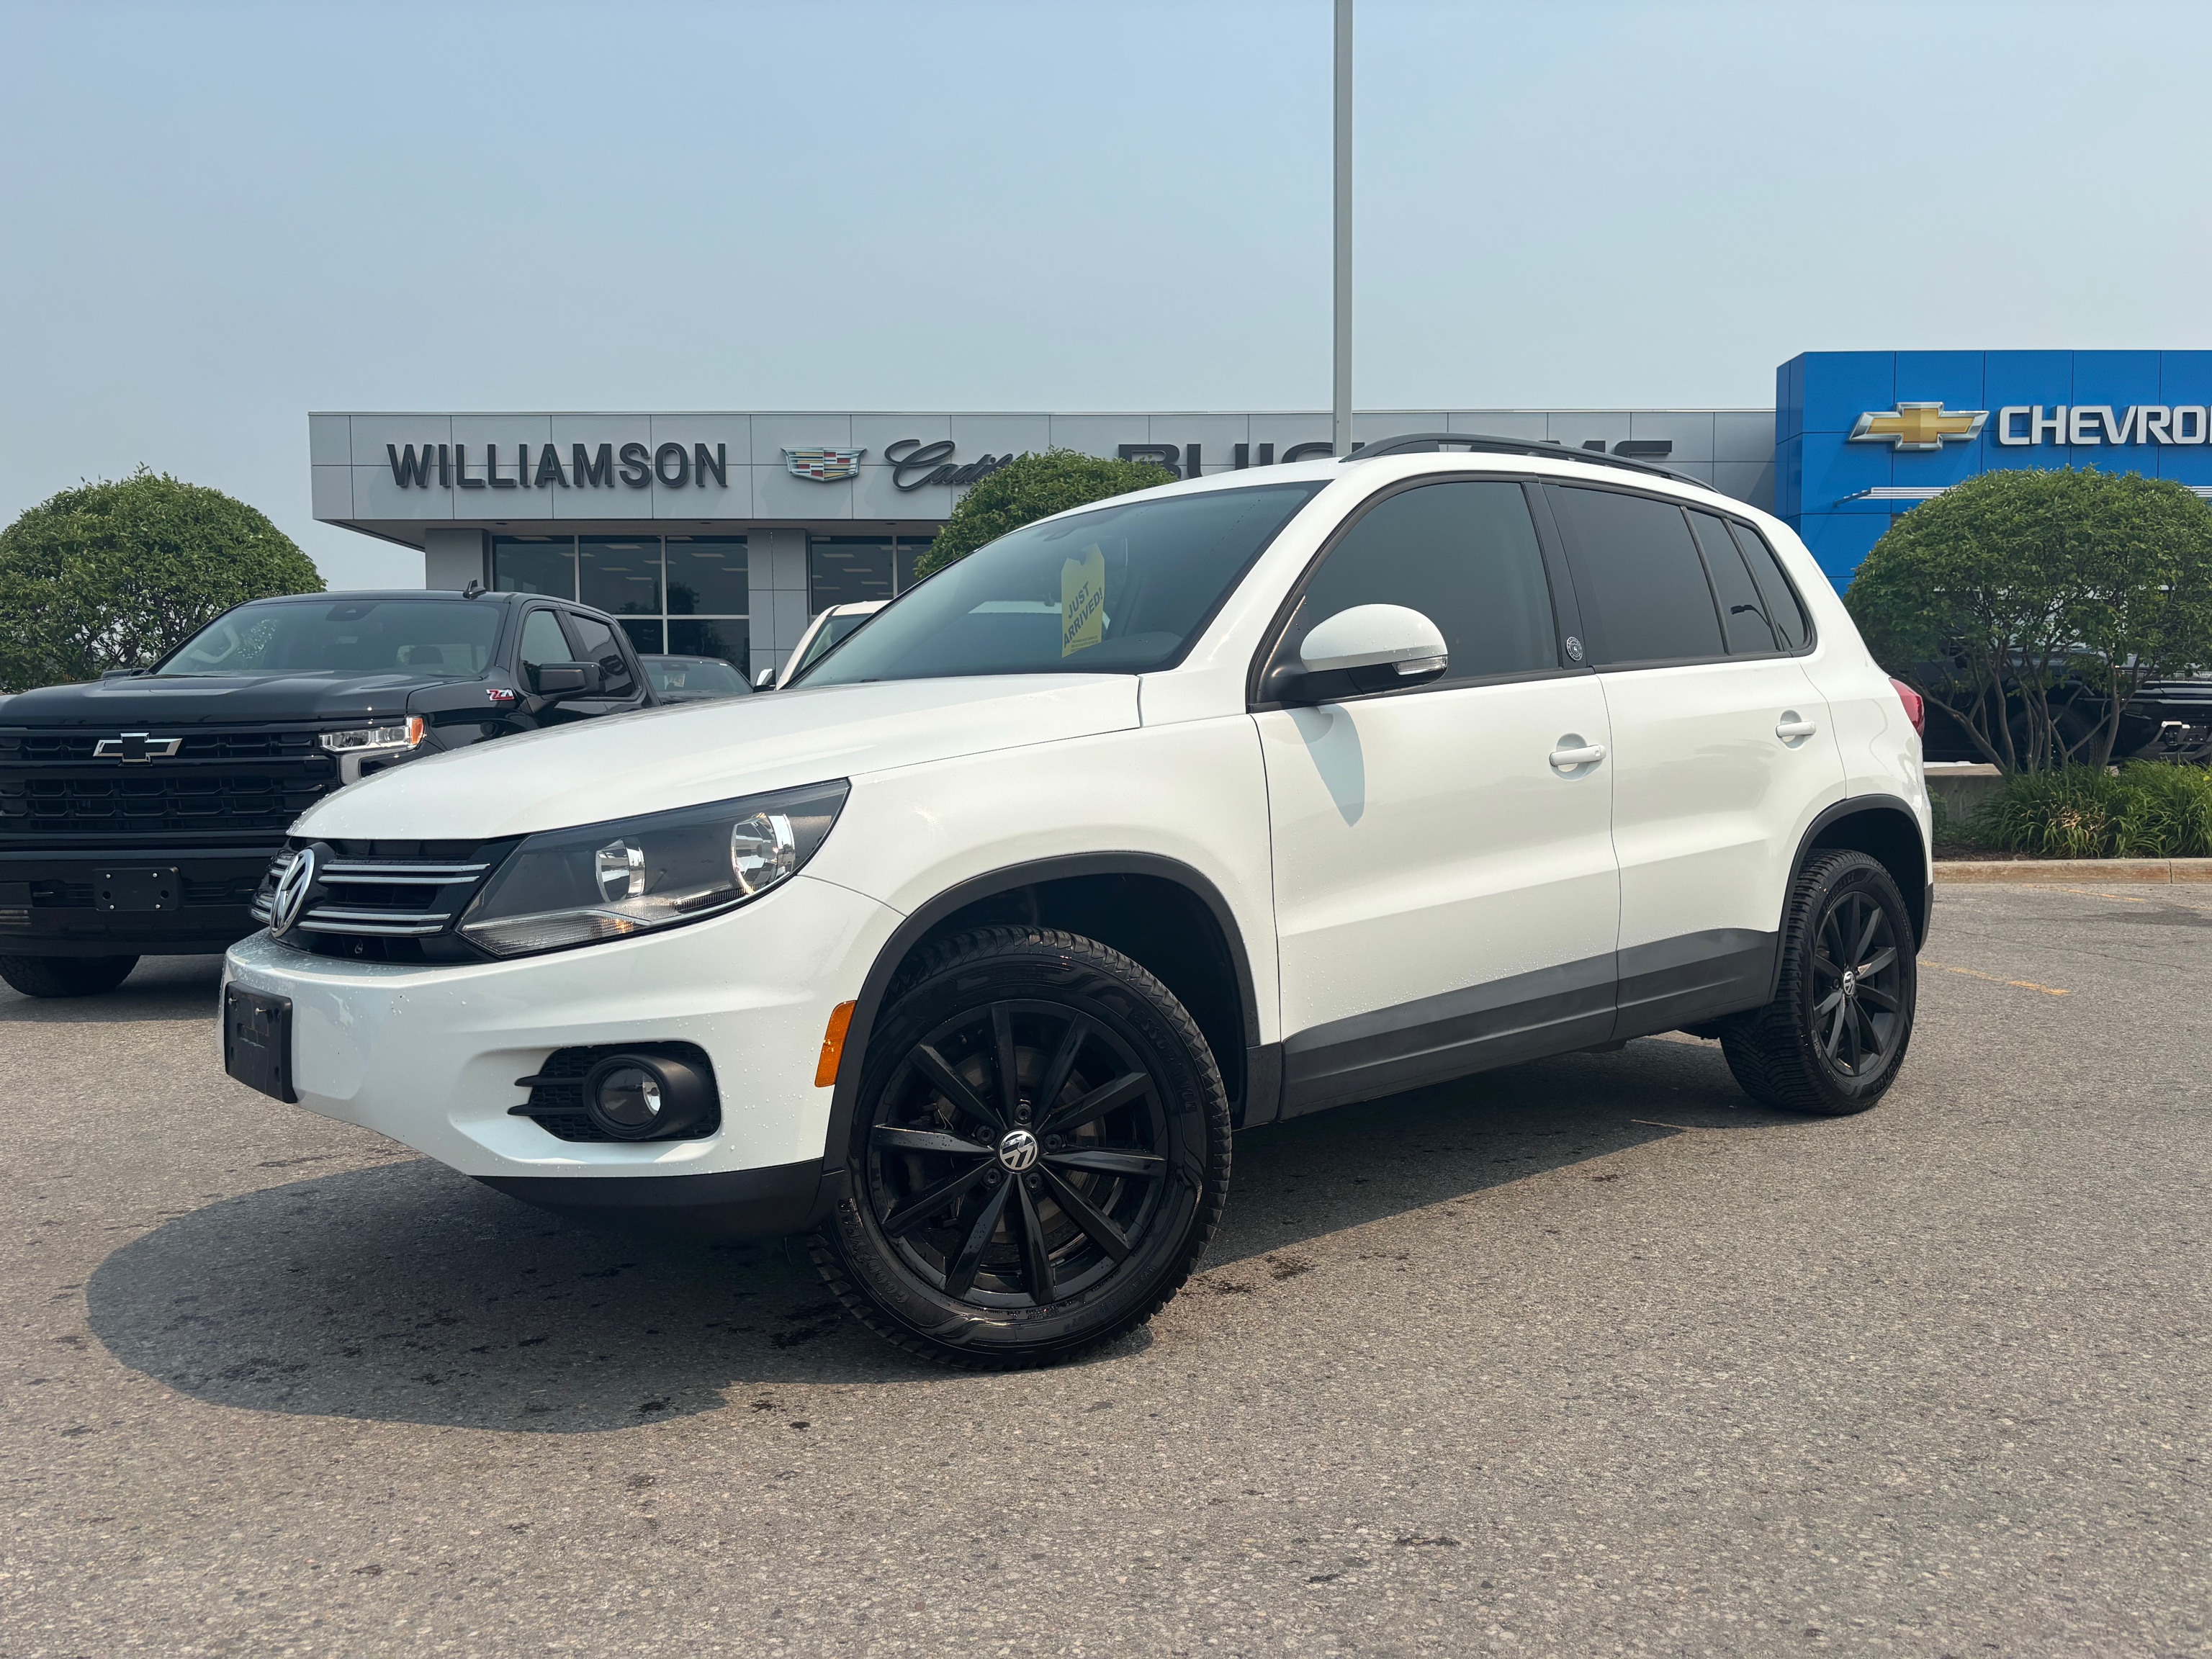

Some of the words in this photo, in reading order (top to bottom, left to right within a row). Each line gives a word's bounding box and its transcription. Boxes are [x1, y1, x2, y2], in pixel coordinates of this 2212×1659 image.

[1998, 405, 2212, 445] CHEVRO
[386, 442, 728, 487] WILLIAMSON
[1064, 587, 1103, 648] ARRIVED!
[1068, 580, 1090, 619] JUST
[837, 1197, 909, 1303] GOODYEAR
